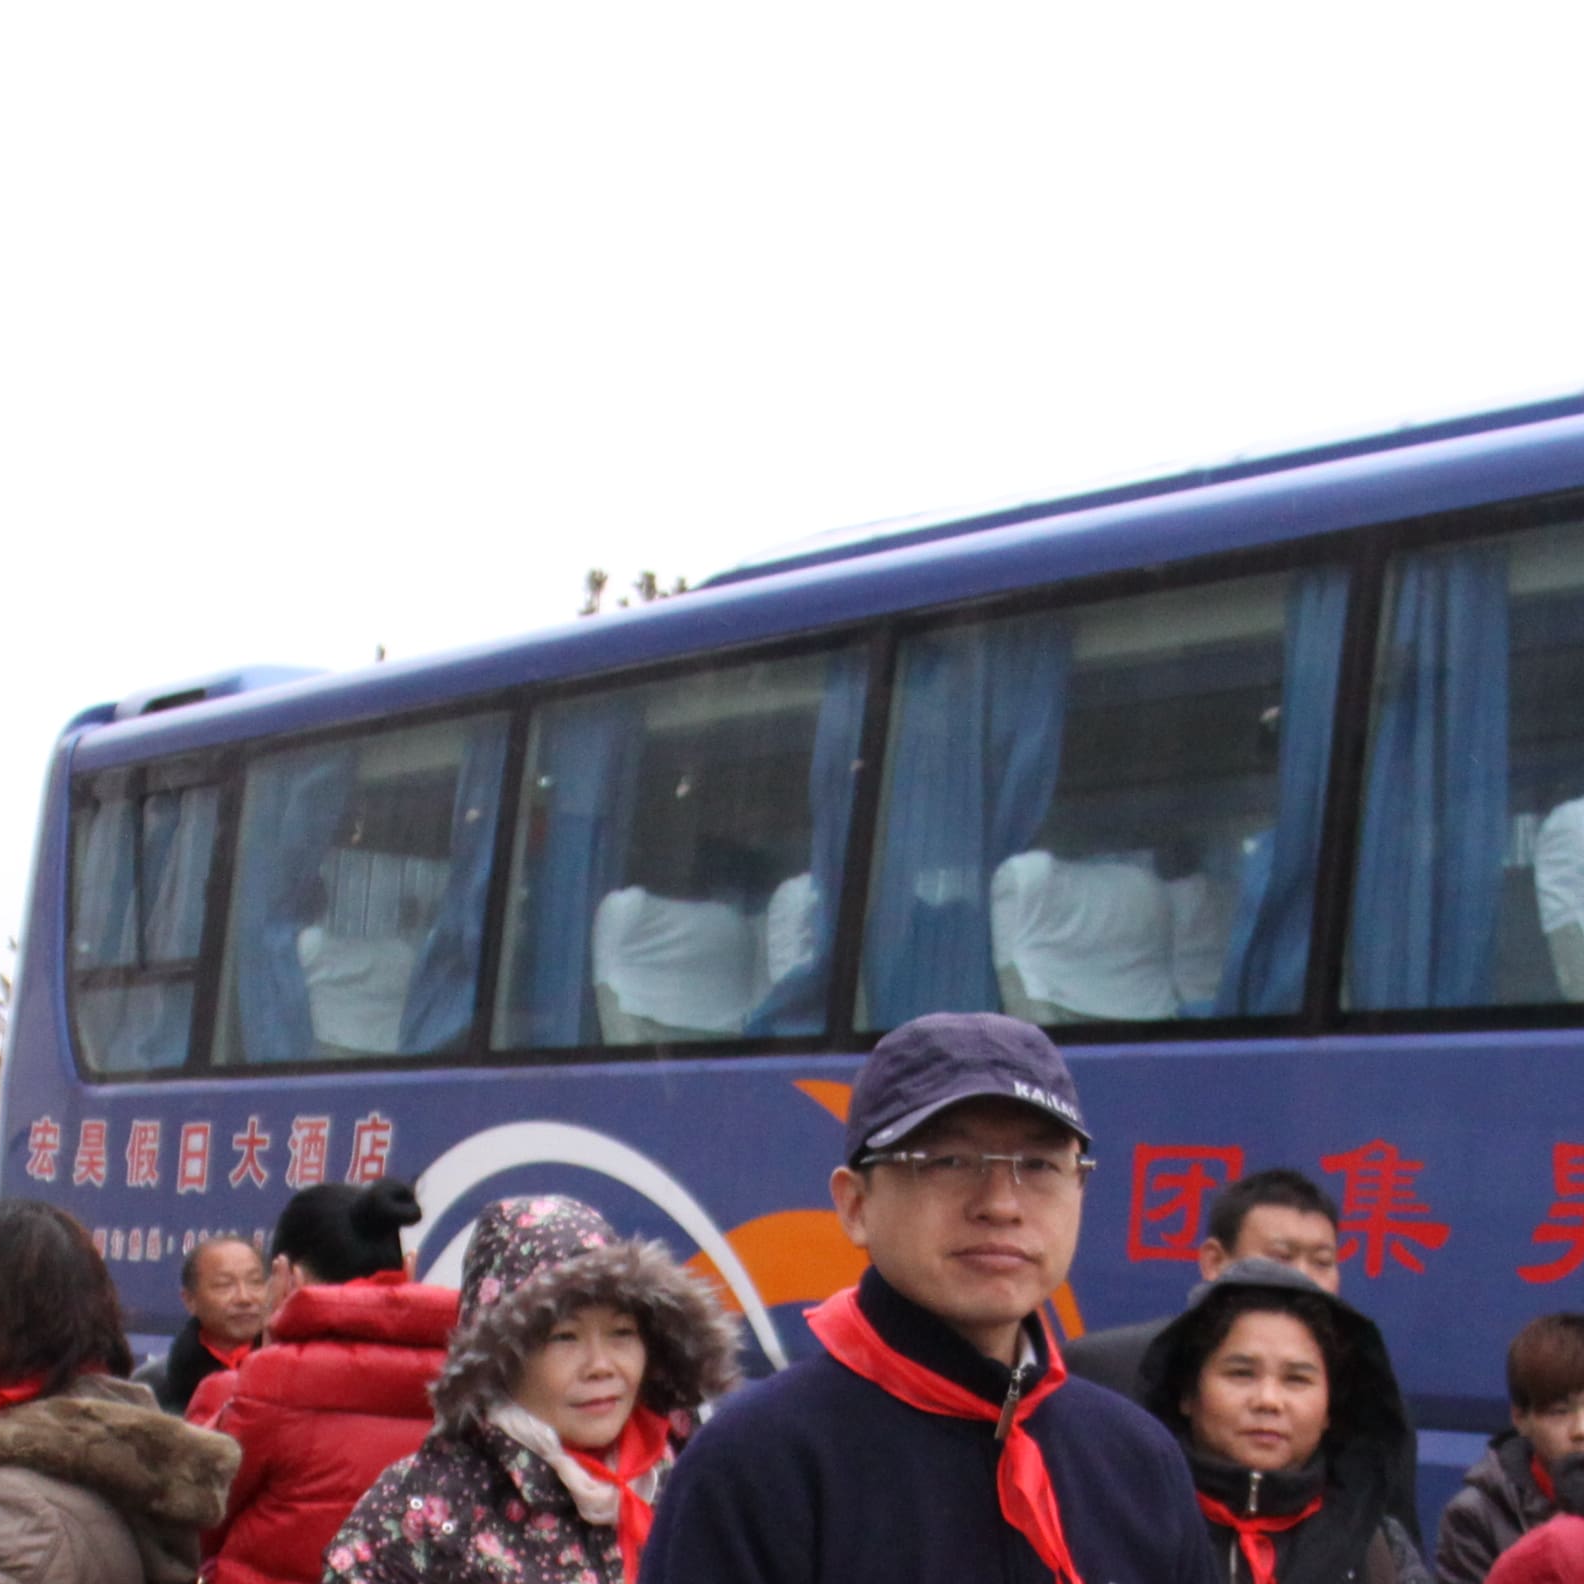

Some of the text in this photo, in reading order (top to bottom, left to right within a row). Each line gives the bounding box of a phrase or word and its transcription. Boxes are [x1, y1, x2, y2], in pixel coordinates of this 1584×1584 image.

[26, 1110, 393, 1194] 宏昊假日大酒店
